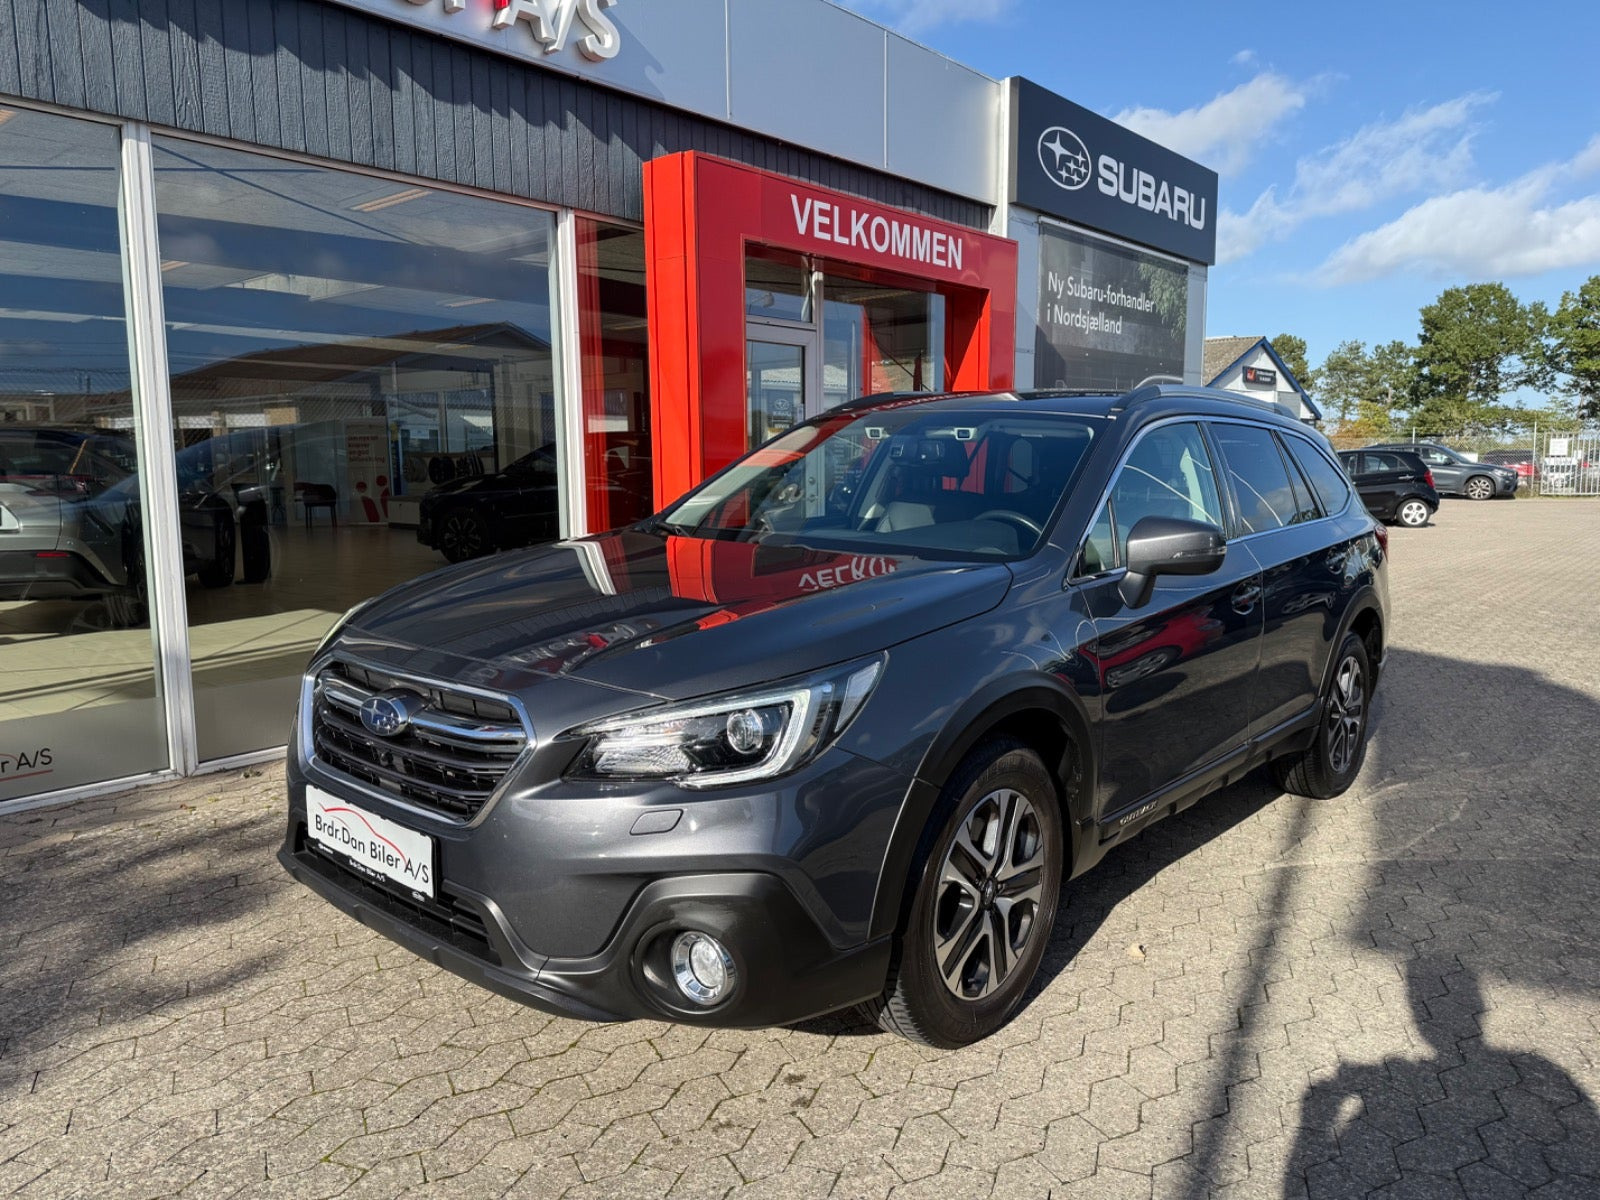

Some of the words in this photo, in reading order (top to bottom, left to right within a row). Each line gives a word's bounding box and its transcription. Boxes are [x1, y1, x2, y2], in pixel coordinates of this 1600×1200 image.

[1097, 153, 1206, 231] SUBARU
[790, 193, 964, 271] VELKOMMEN
[1046, 302, 1051, 323] i
[1053, 303, 1123, 335] Nordsjælland
[1047, 270, 1065, 300] Ny
[1066, 275, 1155, 313] Subaru-forhandler
[16, 747, 53, 771] A/S
[315, 813, 365, 854] Brdr.Dan
[369, 840, 401, 869] Biler
[403, 856, 430, 884] A/S
